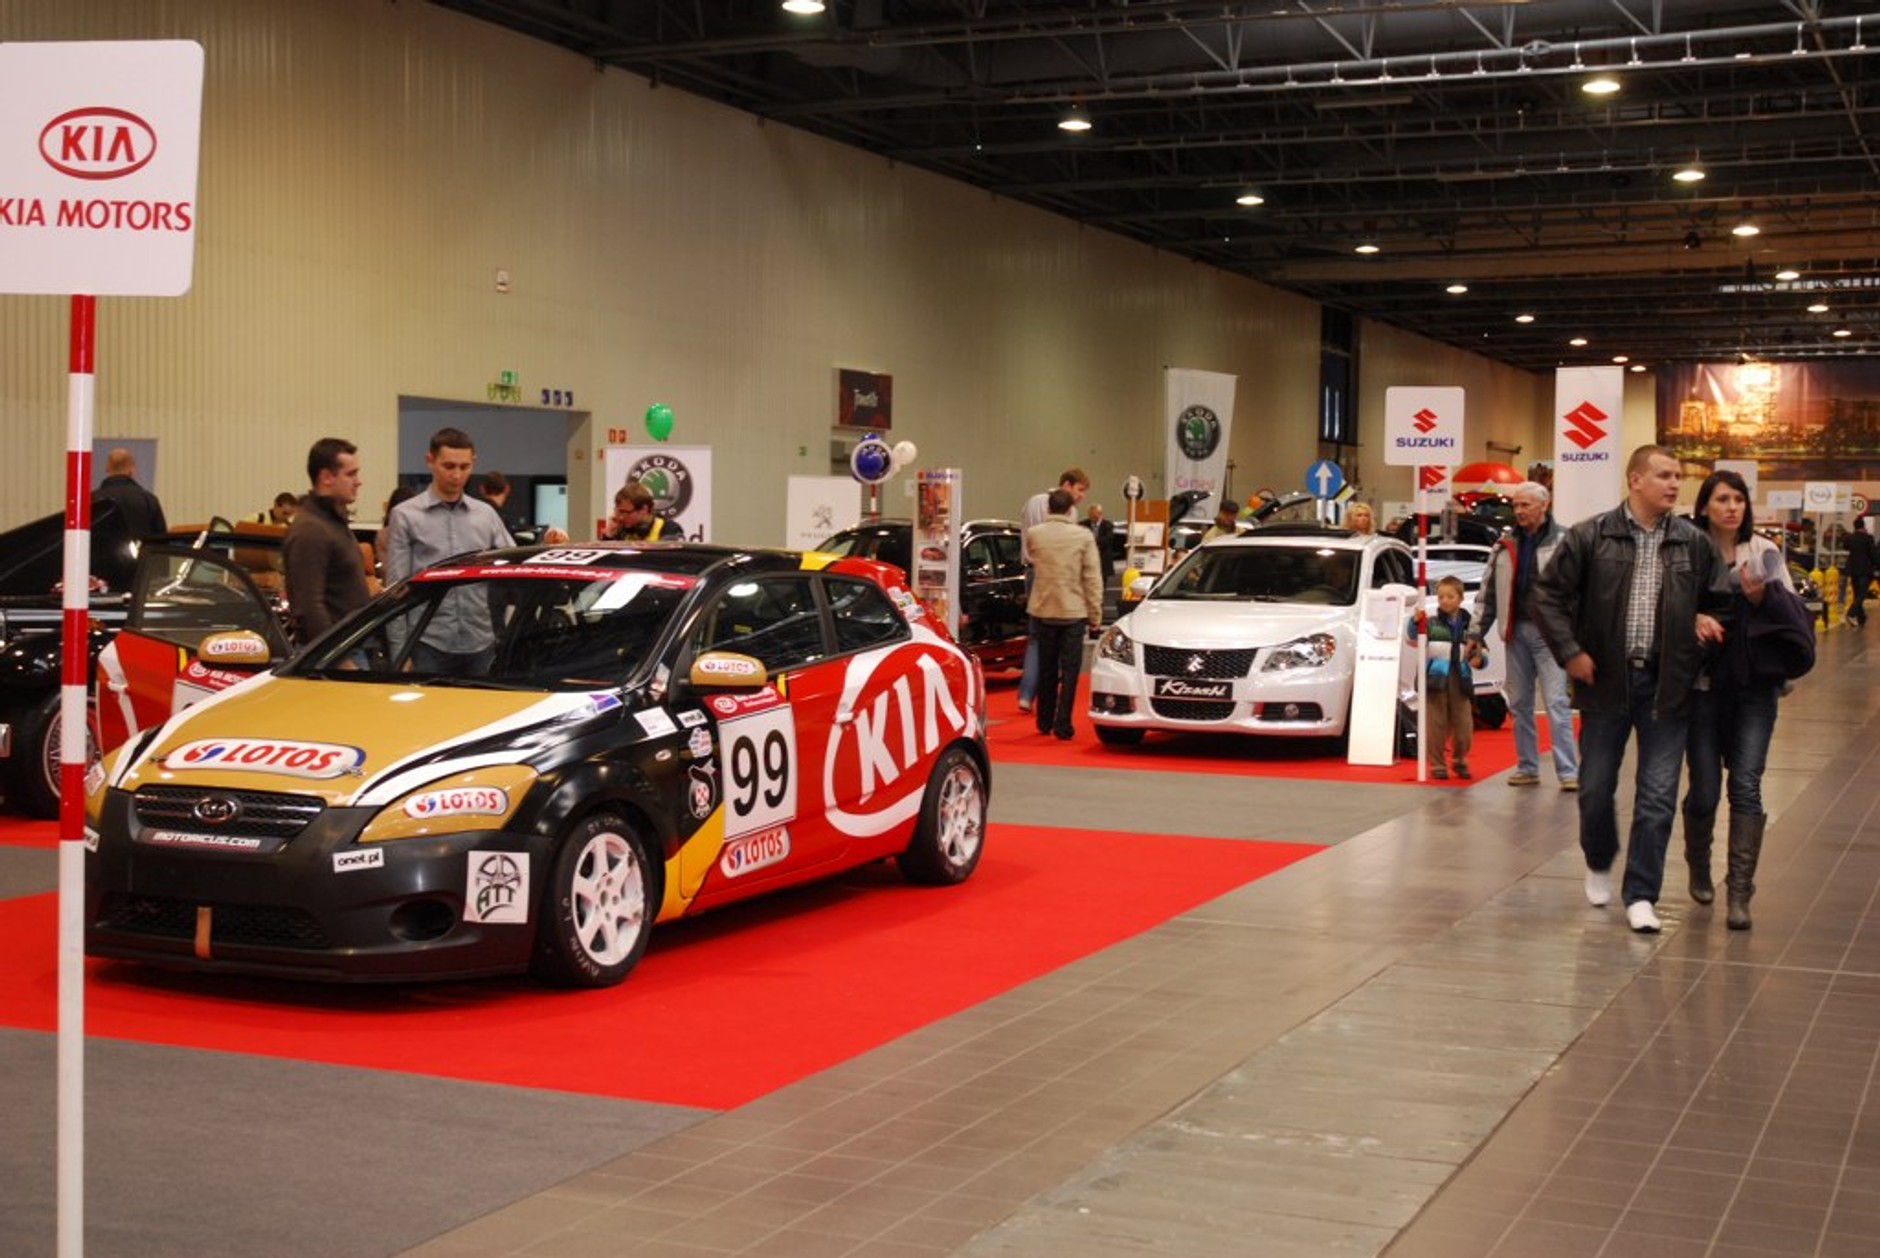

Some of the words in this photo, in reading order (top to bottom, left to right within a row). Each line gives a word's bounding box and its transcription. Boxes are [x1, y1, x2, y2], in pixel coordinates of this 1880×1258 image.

[61, 125, 136, 162] KIA
[0, 198, 46, 226] KIA
[56, 200, 192, 231] MOTORS
[1395, 436, 1455, 448] SUZUKI
[1560, 451, 1610, 463] SUZUKI
[854, 653, 966, 805] KIA
[221, 743, 342, 771] LOTOS
[731, 729, 789, 817] 99
[440, 790, 498, 810] LOTOS
[152, 832, 261, 848] MOTORICUS.COM
[744, 828, 783, 866] LOTOS
[337, 851, 380, 868] onet.pl
[476, 883, 517, 914] ATT
